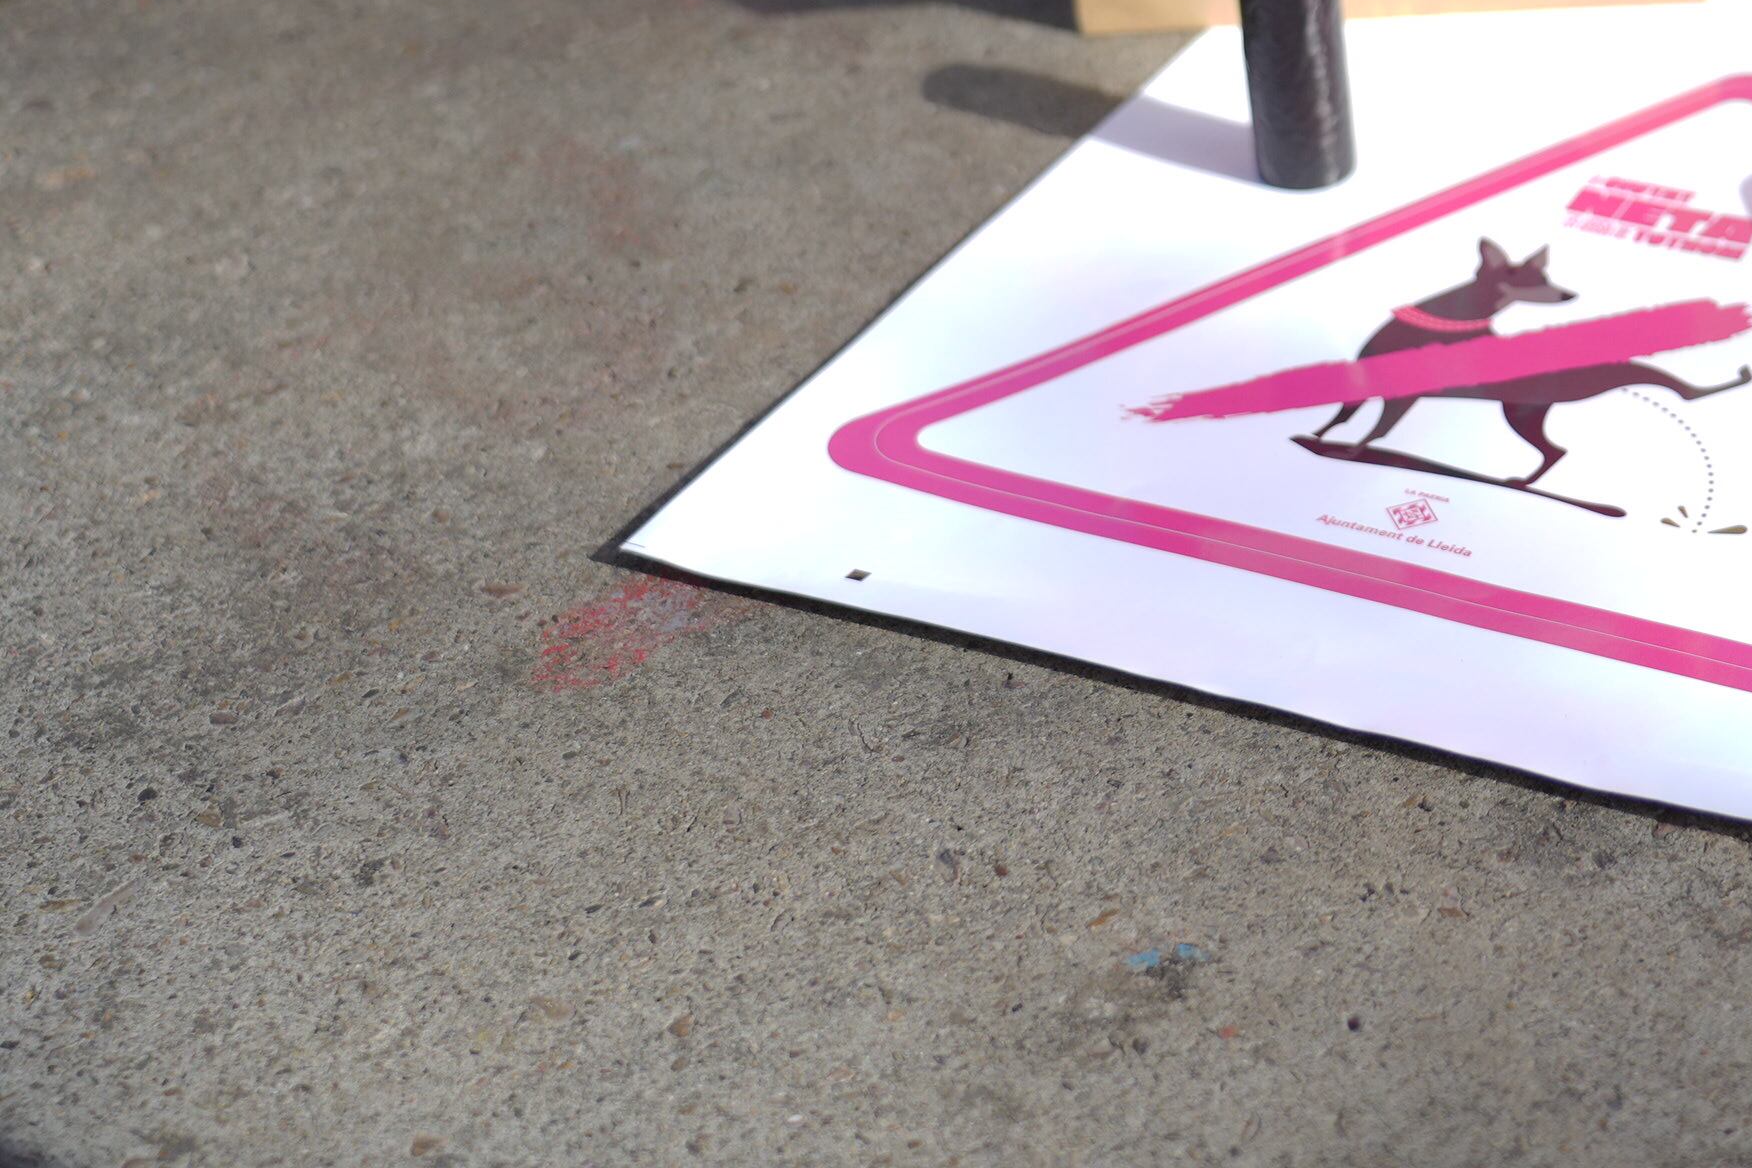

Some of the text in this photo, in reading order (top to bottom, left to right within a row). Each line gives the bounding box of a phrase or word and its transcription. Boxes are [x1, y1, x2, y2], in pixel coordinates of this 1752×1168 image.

[1316, 513, 1473, 558] Ajuntament de Lleida
